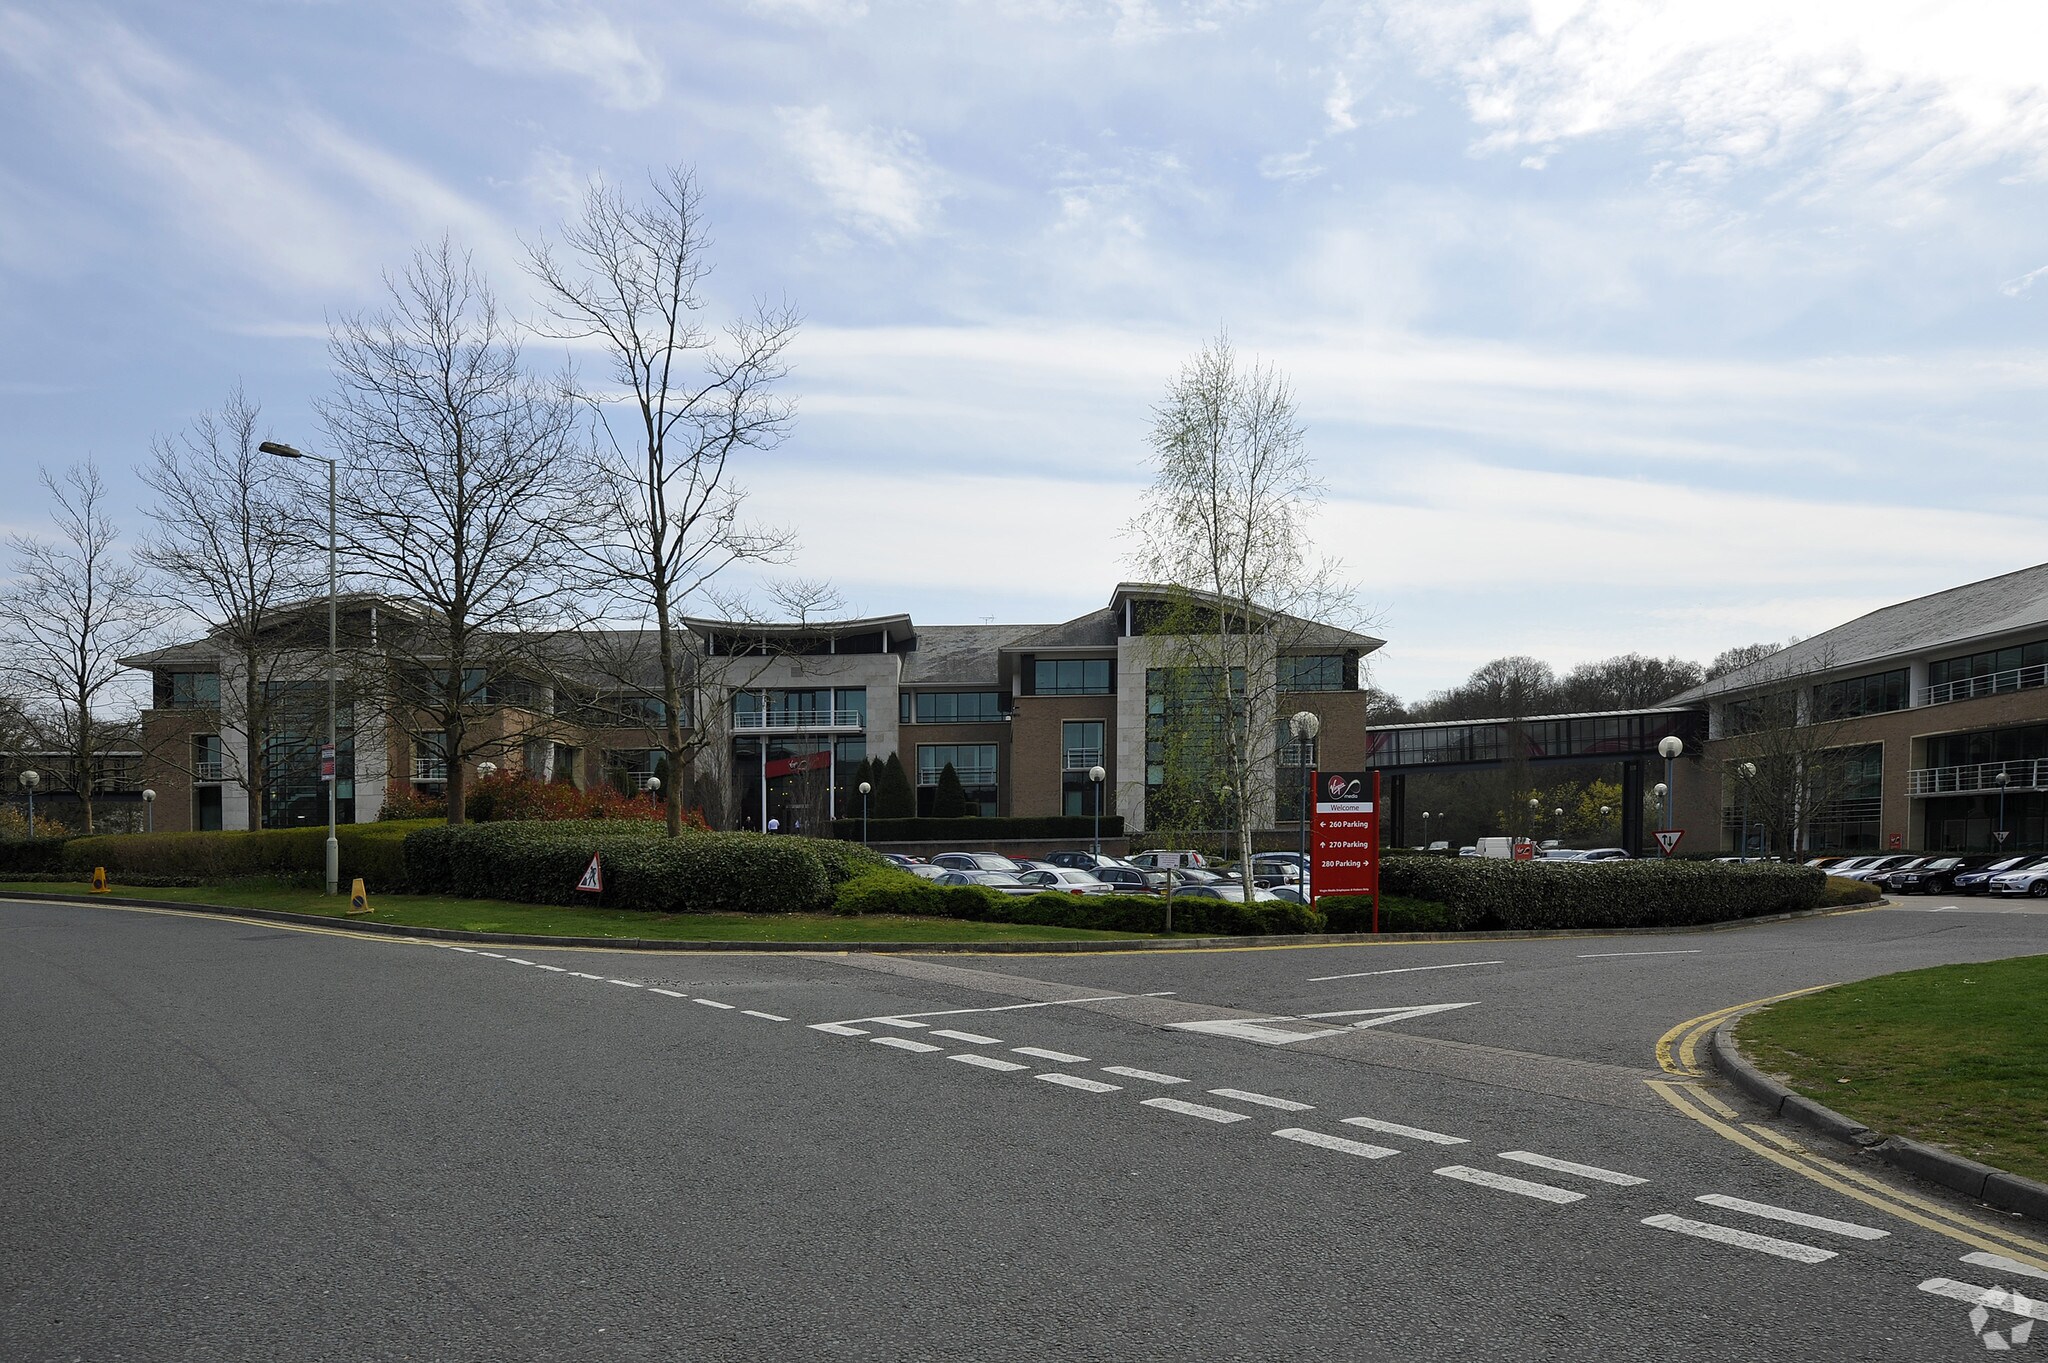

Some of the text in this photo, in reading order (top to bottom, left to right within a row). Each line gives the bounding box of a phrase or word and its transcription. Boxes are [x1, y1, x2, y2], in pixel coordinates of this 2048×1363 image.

[1330, 779, 1346, 795] Virgin
[1342, 821, 1369, 829] Parking
[1342, 841, 1369, 849] Parking
[1321, 860, 1361, 868] 280 Parking
